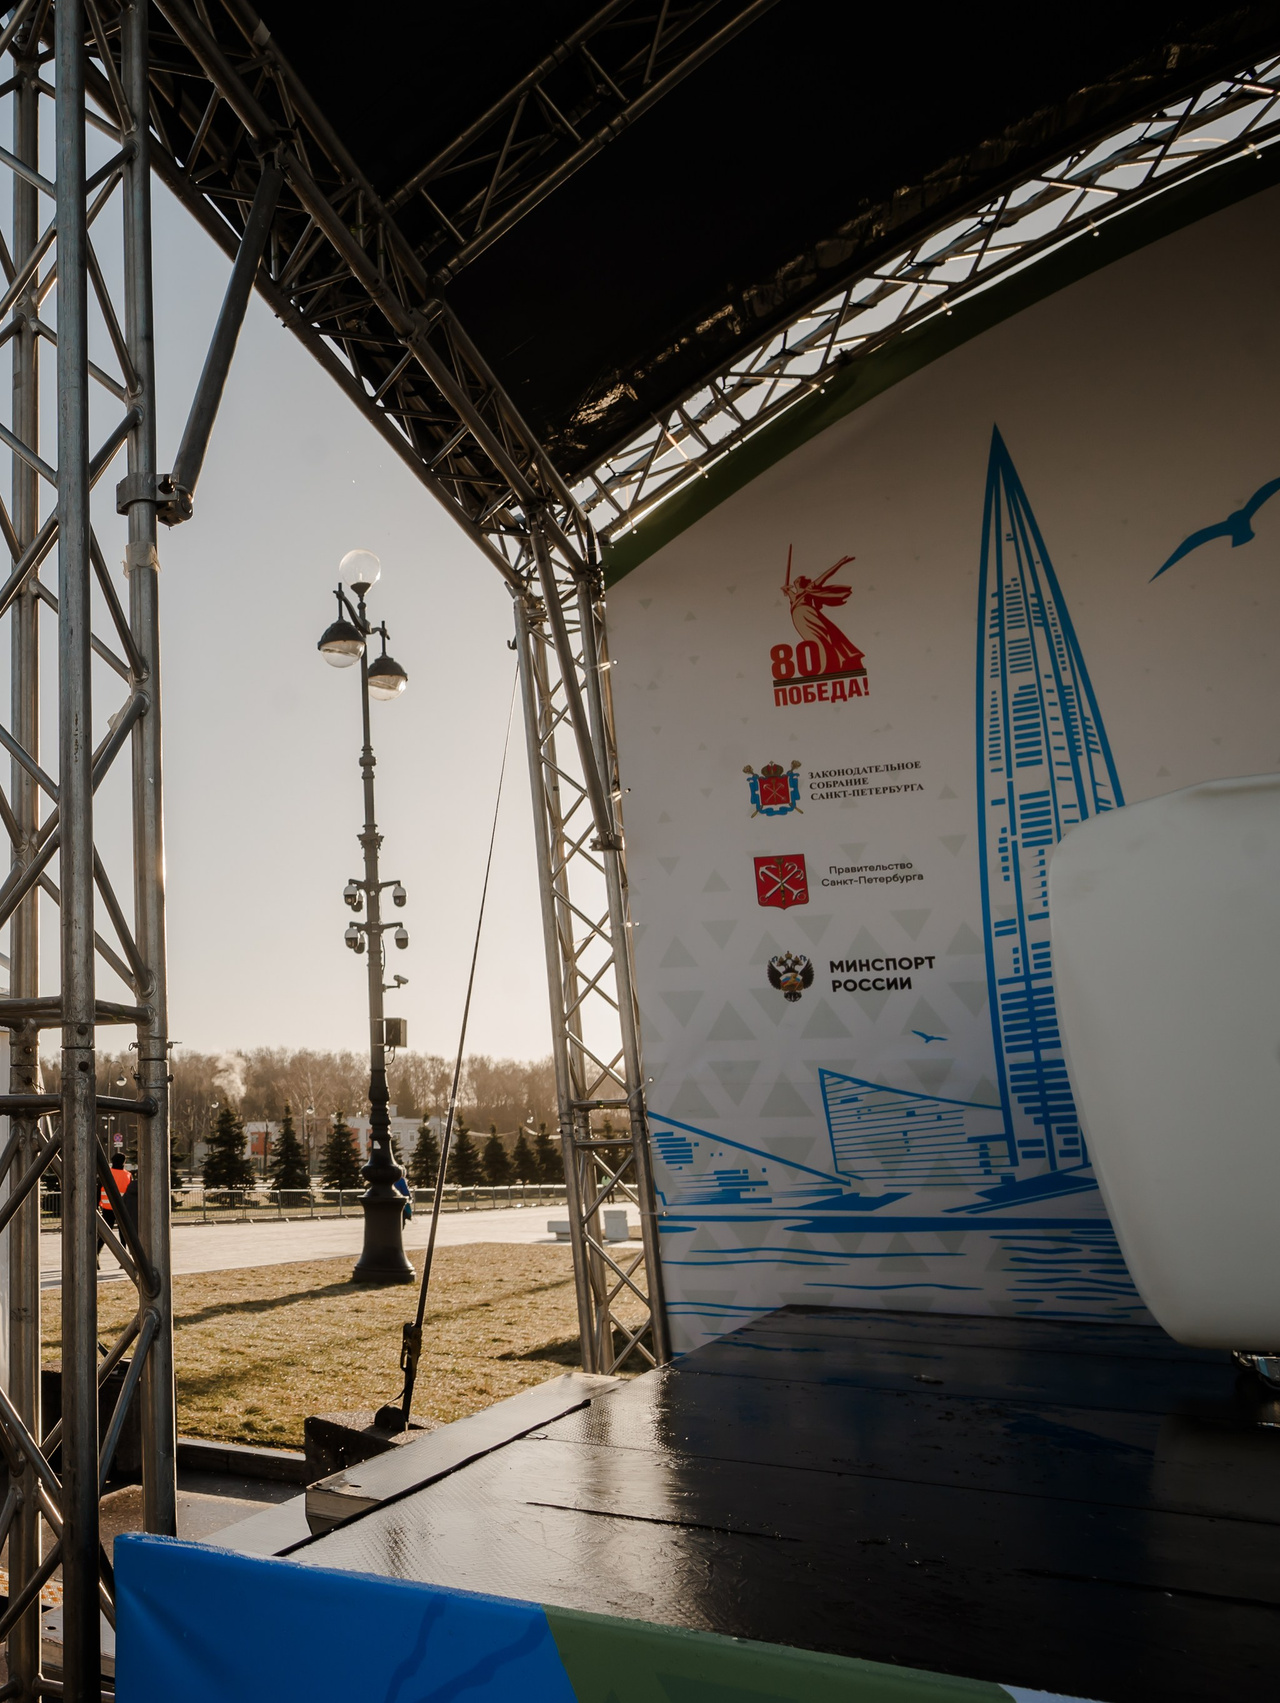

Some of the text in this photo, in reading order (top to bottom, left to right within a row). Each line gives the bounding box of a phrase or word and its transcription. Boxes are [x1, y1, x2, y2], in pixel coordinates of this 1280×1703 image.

[770, 640, 821, 680] 80
[773, 677, 870, 707] ПОБЕДА!
[808, 761, 922, 780] ЗАКОНОДАТЕЛЬНОЕ
[809, 777, 869, 790] СОБРАНИЕ
[810, 783, 924, 801] САНКТ-ПЕТЕРБУРГА
[829, 862, 913, 876] Правительство
[821, 873, 924, 887] Санкт-Петербурга
[829, 956, 935, 973] МИНСПОРТ
[831, 977, 912, 992] РОССИИ
